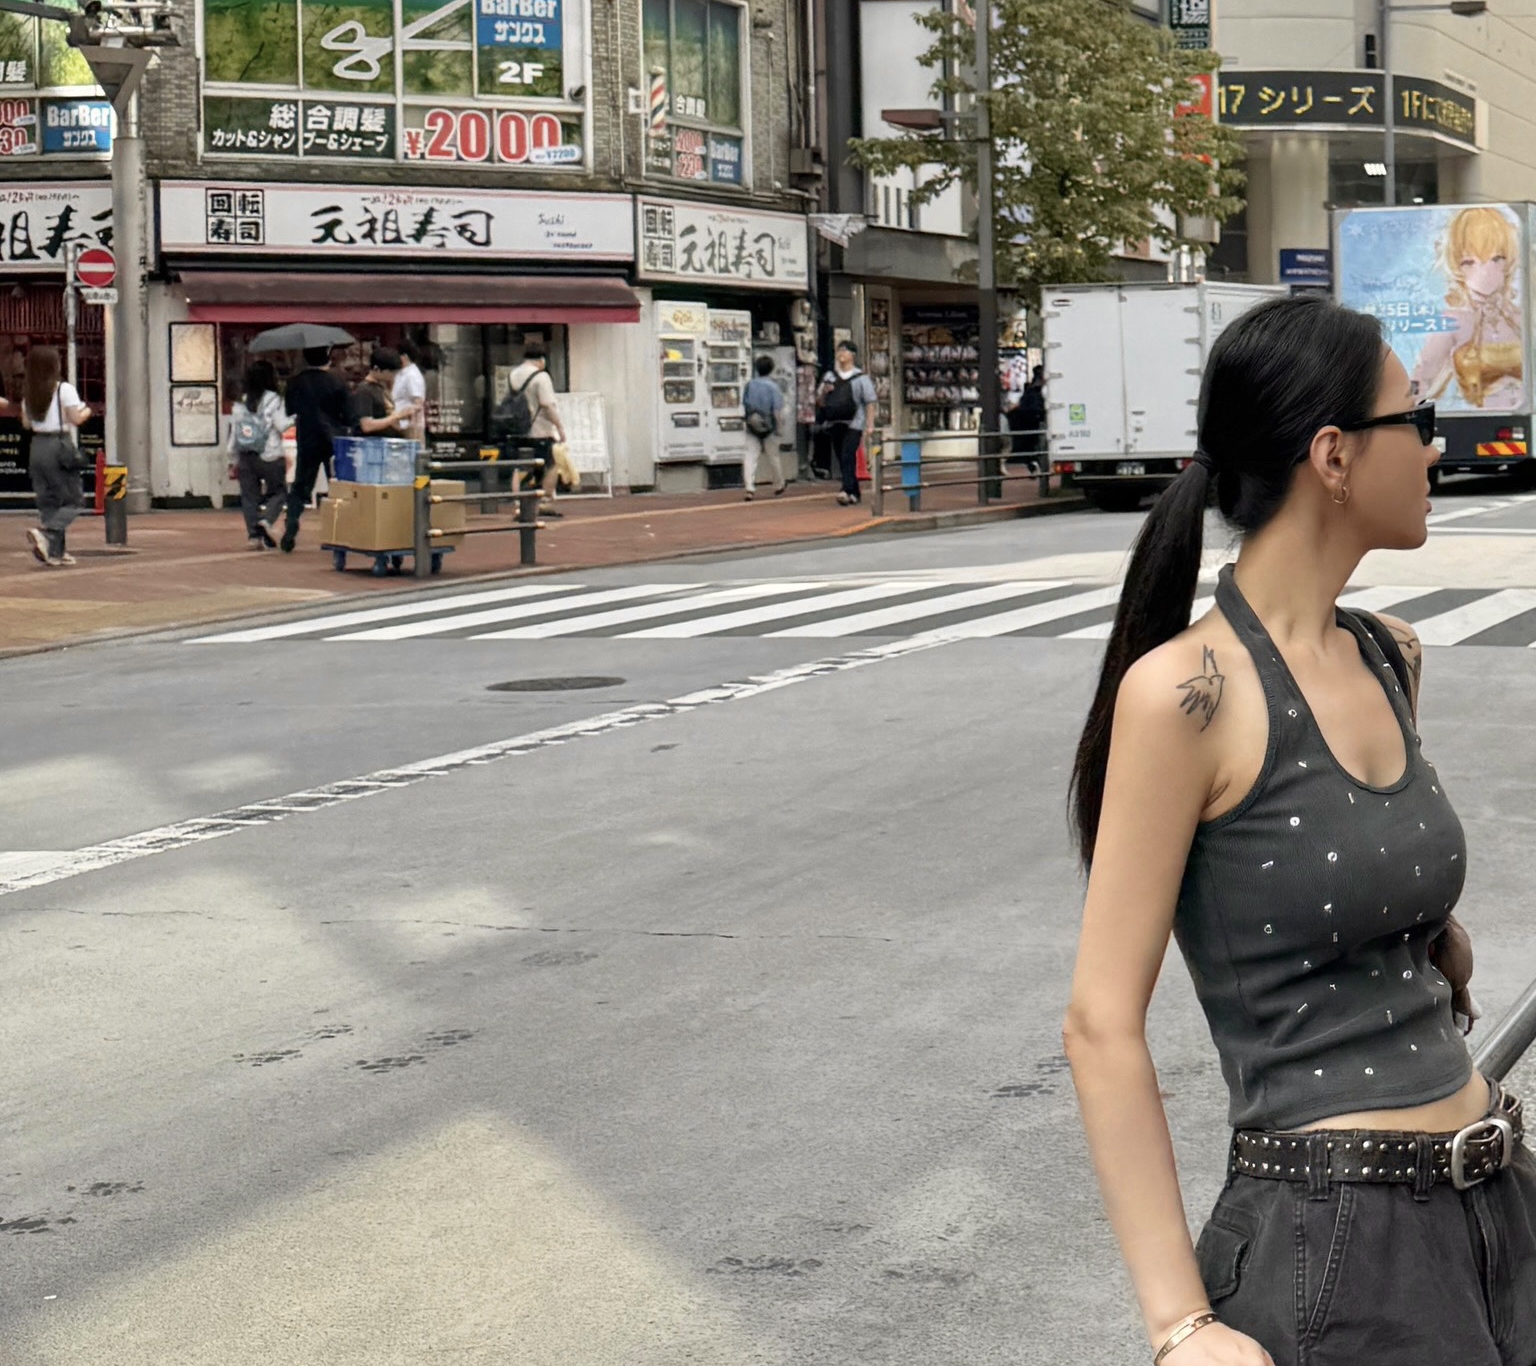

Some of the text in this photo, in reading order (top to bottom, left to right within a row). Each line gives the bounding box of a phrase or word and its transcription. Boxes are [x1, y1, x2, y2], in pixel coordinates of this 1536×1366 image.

[494, 22, 546, 45] サンクス
[499, 63, 545, 85] 2F
[1257, 85, 1376, 116] シリーズ
[47, 104, 110, 128] BarBer
[270, 104, 387, 134] 総合調髪
[310, 205, 495, 249] 元祖寿司
[679, 224, 777, 279] 元祖寿司
